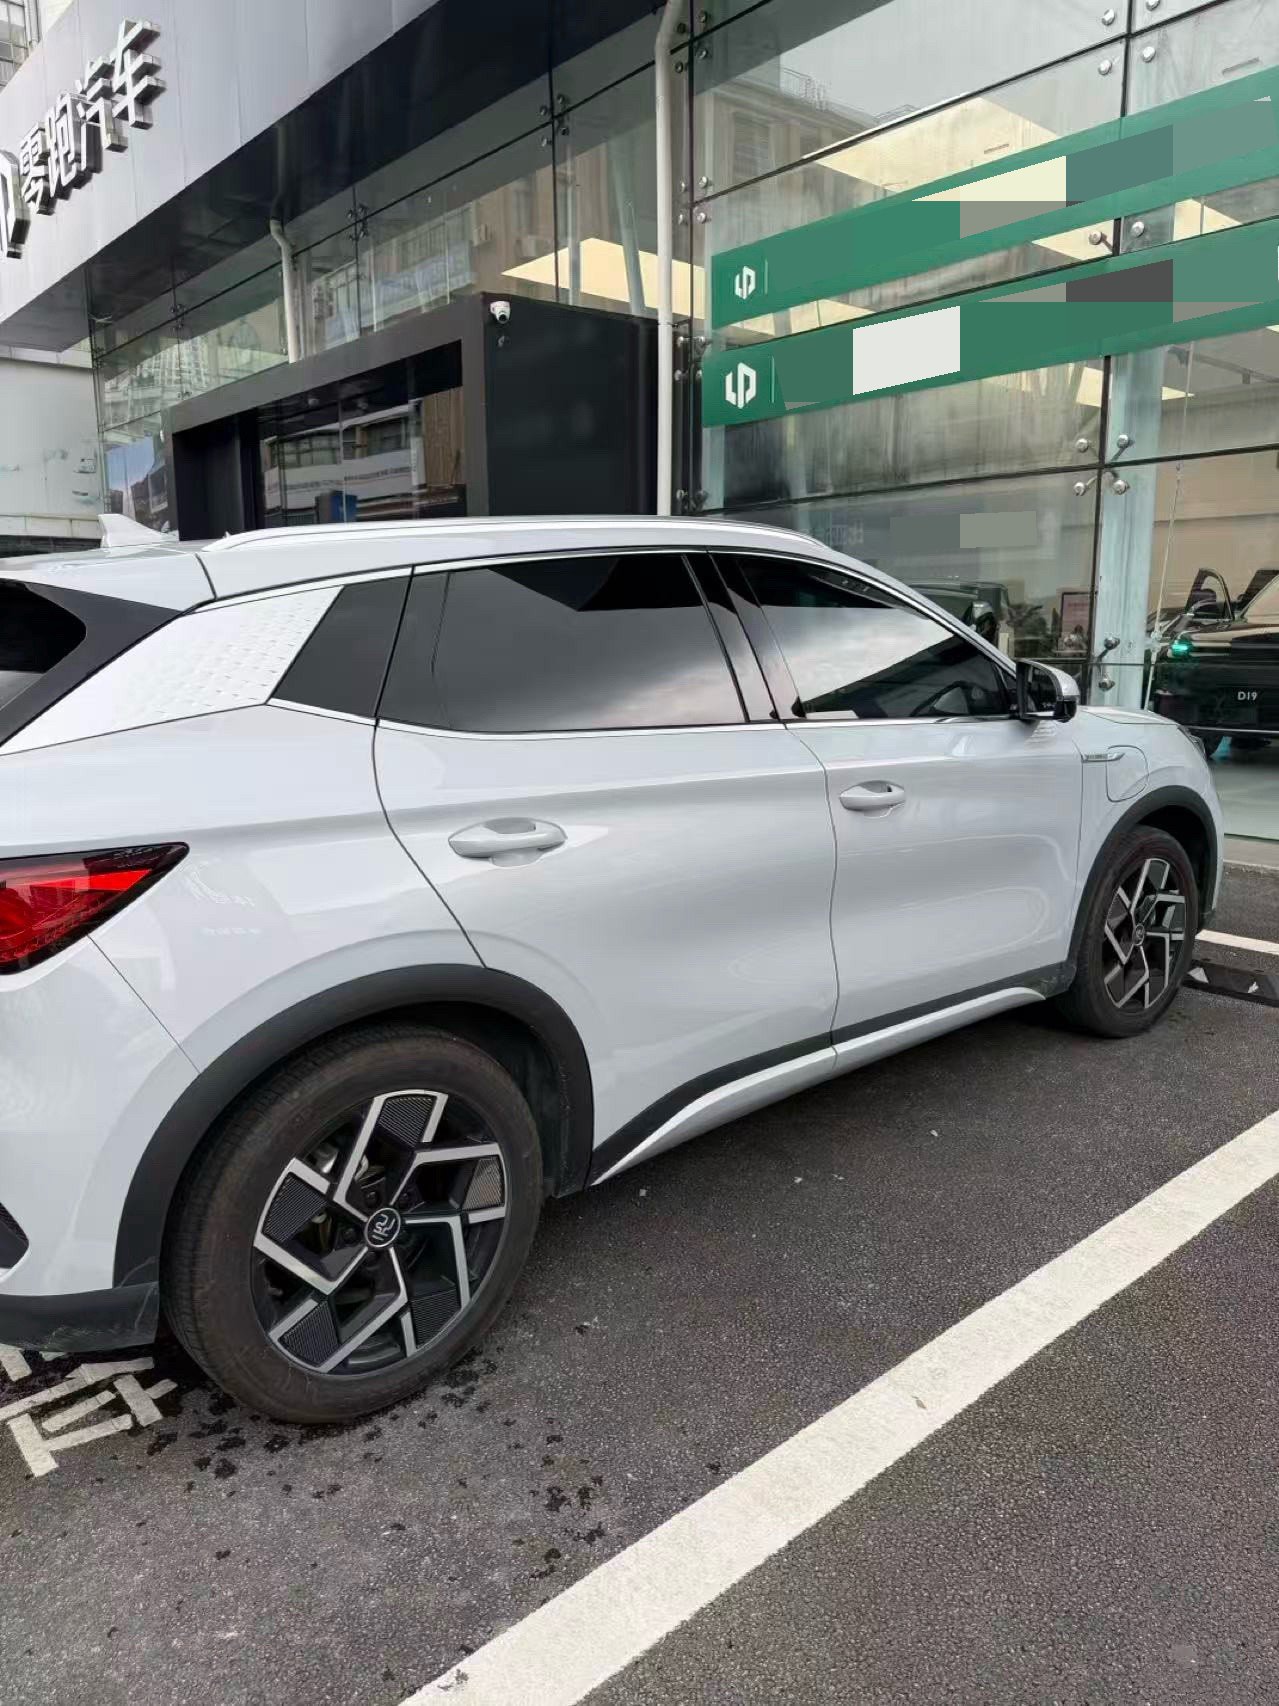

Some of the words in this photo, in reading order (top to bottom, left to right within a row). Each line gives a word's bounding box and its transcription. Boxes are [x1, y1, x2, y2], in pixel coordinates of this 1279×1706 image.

[20, 17, 167, 216] 零跑汽车
[1237, 691, 1257, 701] D19
